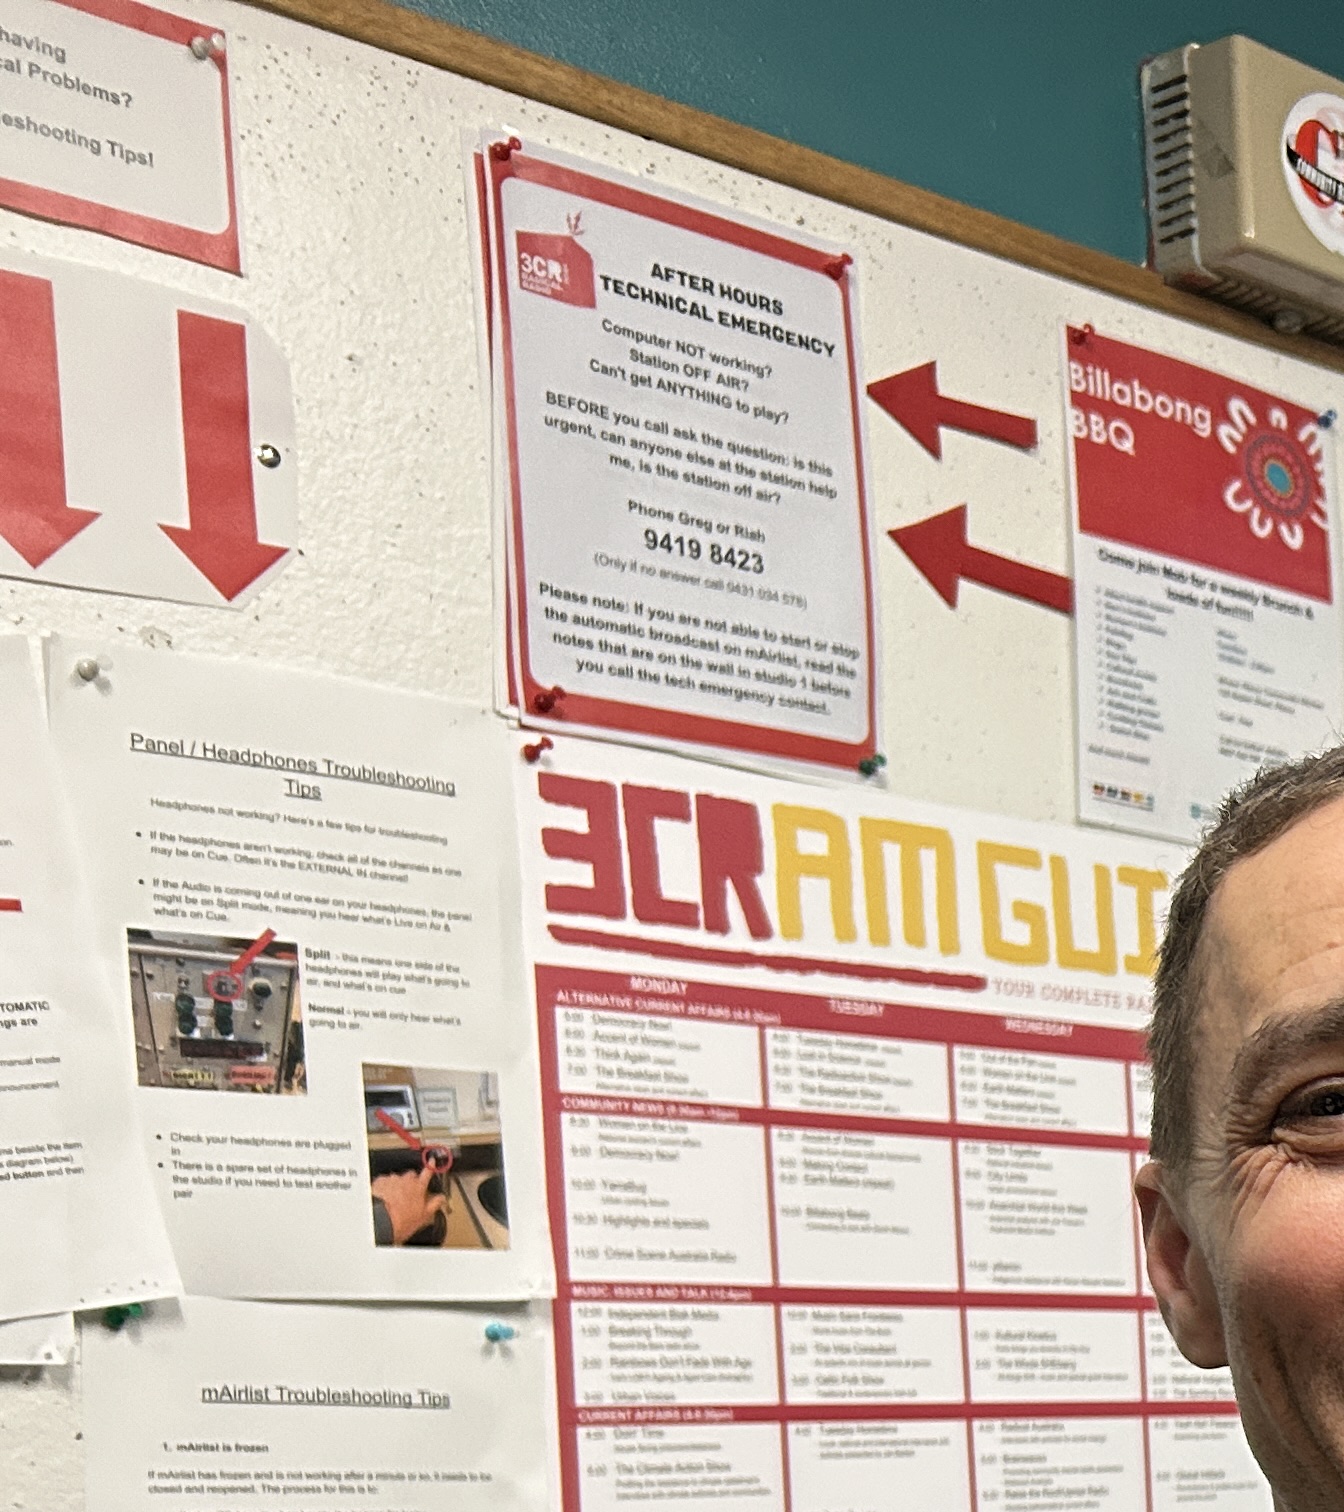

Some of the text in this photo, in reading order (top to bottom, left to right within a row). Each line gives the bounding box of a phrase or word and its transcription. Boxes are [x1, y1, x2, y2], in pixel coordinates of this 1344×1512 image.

[28, 62, 132, 108] Problems?
[106, 139, 153, 168] Tips!
[520, 252, 562, 283] 3CR
[651, 263, 783, 316] AFTER HOURS
[600, 274, 713, 322] TECHNICAL
[718, 310, 834, 357] EMERGENCY
[602, 318, 772, 379] Computer NOT working?
[630, 348, 749, 392] Station OFF AIR?
[590, 358, 788, 423] Can't get ANYTHING to play?
[1069, 361, 1213, 438] Billabong
[546, 390, 832, 477] BEFORE you call ask the question: is this
[1071, 406, 1136, 456] BBQ
[545, 415, 837, 499] urgent, can anyone else at the station help
[610, 454, 781, 504] me, is the station off air?
[628, 499, 674, 522] Phone
[679, 511, 712, 534] Greg
[717, 523, 729, 534] or
[645, 529, 763, 574] 9419 8423
[130, 732, 185, 756] Panel
[202, 742, 318, 774] Headphones
[322, 758, 456, 797] Troubleshooting
[284, 778, 322, 800] Tips
[977, 839, 1170, 976] GUI
[631, 976, 687, 995] MONDAY
[829, 1000, 889, 1015] TUESDAY
[201, 1384, 451, 1409] mAirlist Troubleshooting Tips
